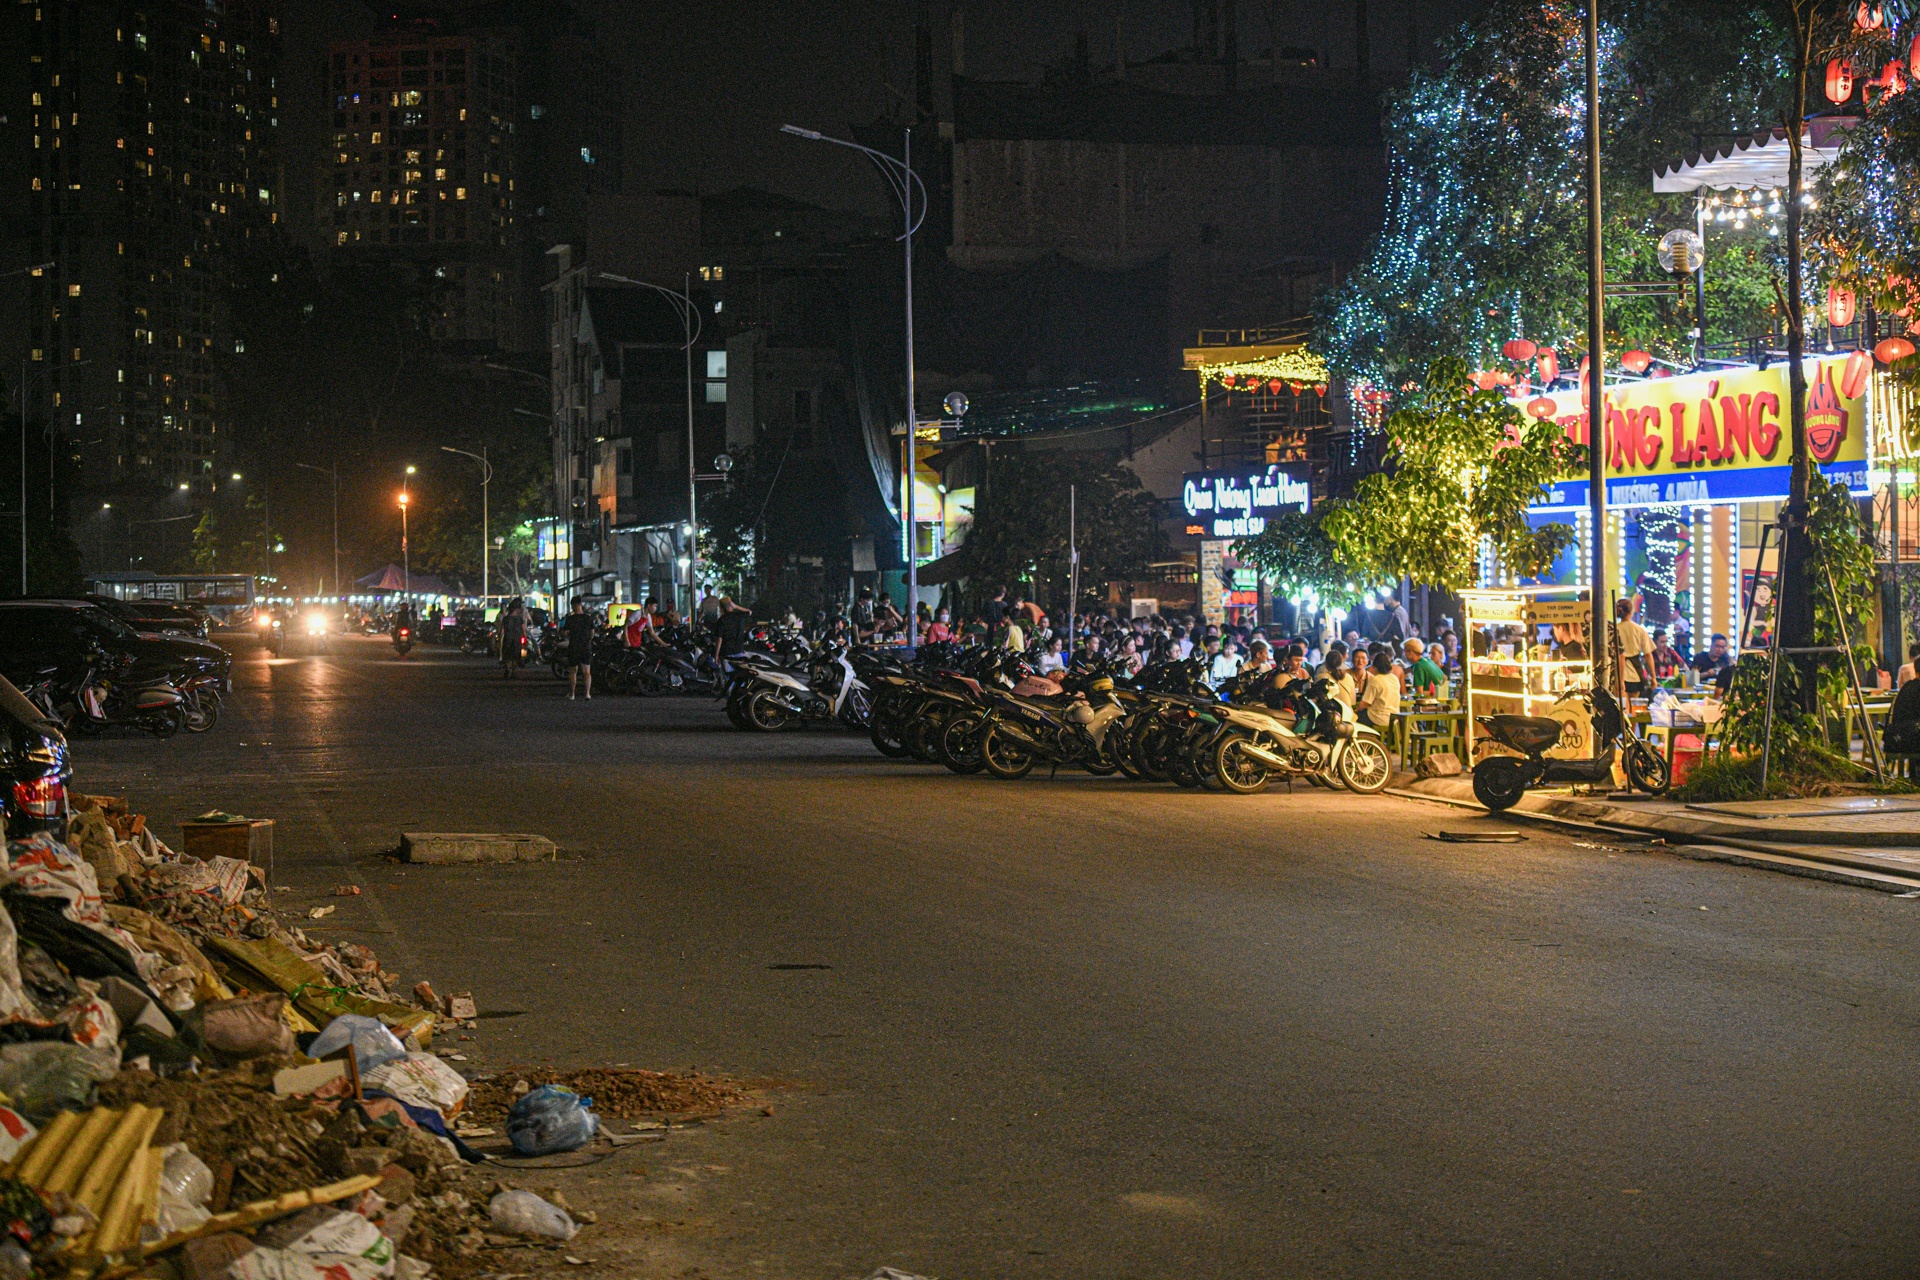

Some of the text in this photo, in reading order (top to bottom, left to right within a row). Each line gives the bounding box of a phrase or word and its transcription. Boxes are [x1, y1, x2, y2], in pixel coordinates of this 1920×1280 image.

[1670, 379, 1782, 464] LÁNG
[1612, 479, 1660, 504] NƯỚNG
[1665, 483, 1676, 502] 4
[1676, 475, 1710, 501] MÙA
